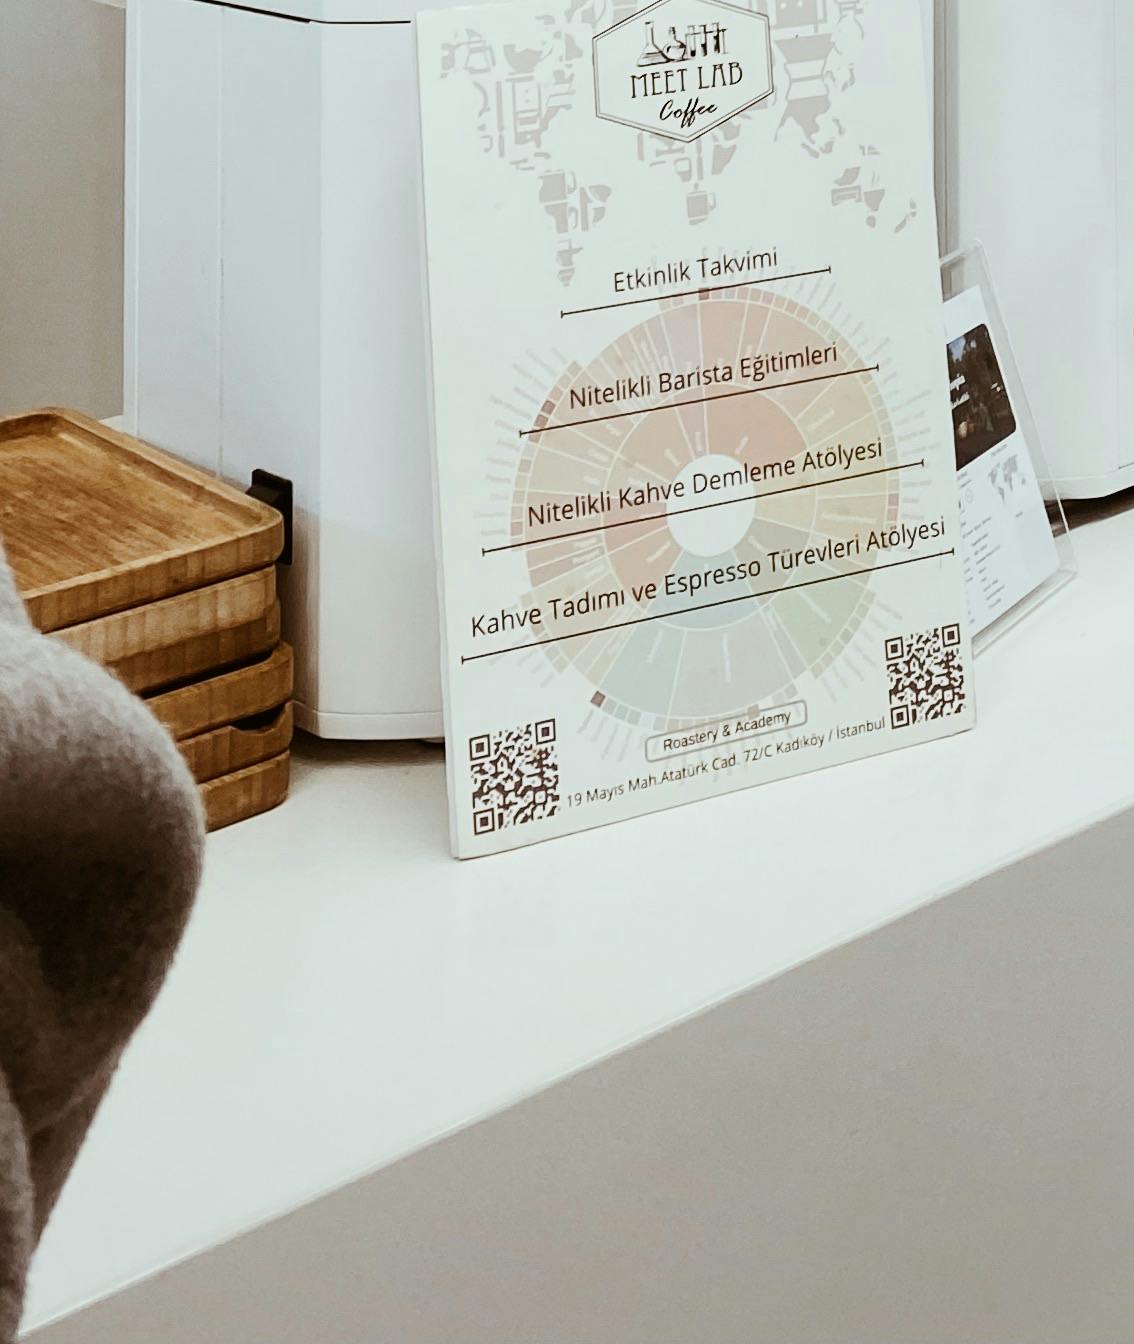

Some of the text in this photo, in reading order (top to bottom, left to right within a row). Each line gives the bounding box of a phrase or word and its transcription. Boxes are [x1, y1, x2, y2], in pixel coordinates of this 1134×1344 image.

[630, 61, 743, 99] MEET LAB
[659, 96, 718, 129] Coffee
[614, 246, 778, 293] Etkinlik Takvimi
[569, 341, 838, 410] Nitelikli Barista Eğitimleri
[528, 437, 882, 527] Nitelikli Kahve Demleme Atölyesi
[471, 515, 946, 638] Kahve Tadımı ve Espresso Türevleri Atölyesi
[663, 712, 792, 752] Roastery & Academy
[567, 792, 582, 808] 19
[586, 784, 625, 803] Mayıs
[743, 744, 774, 763] 72/C
[828, 728, 834, 742] /
